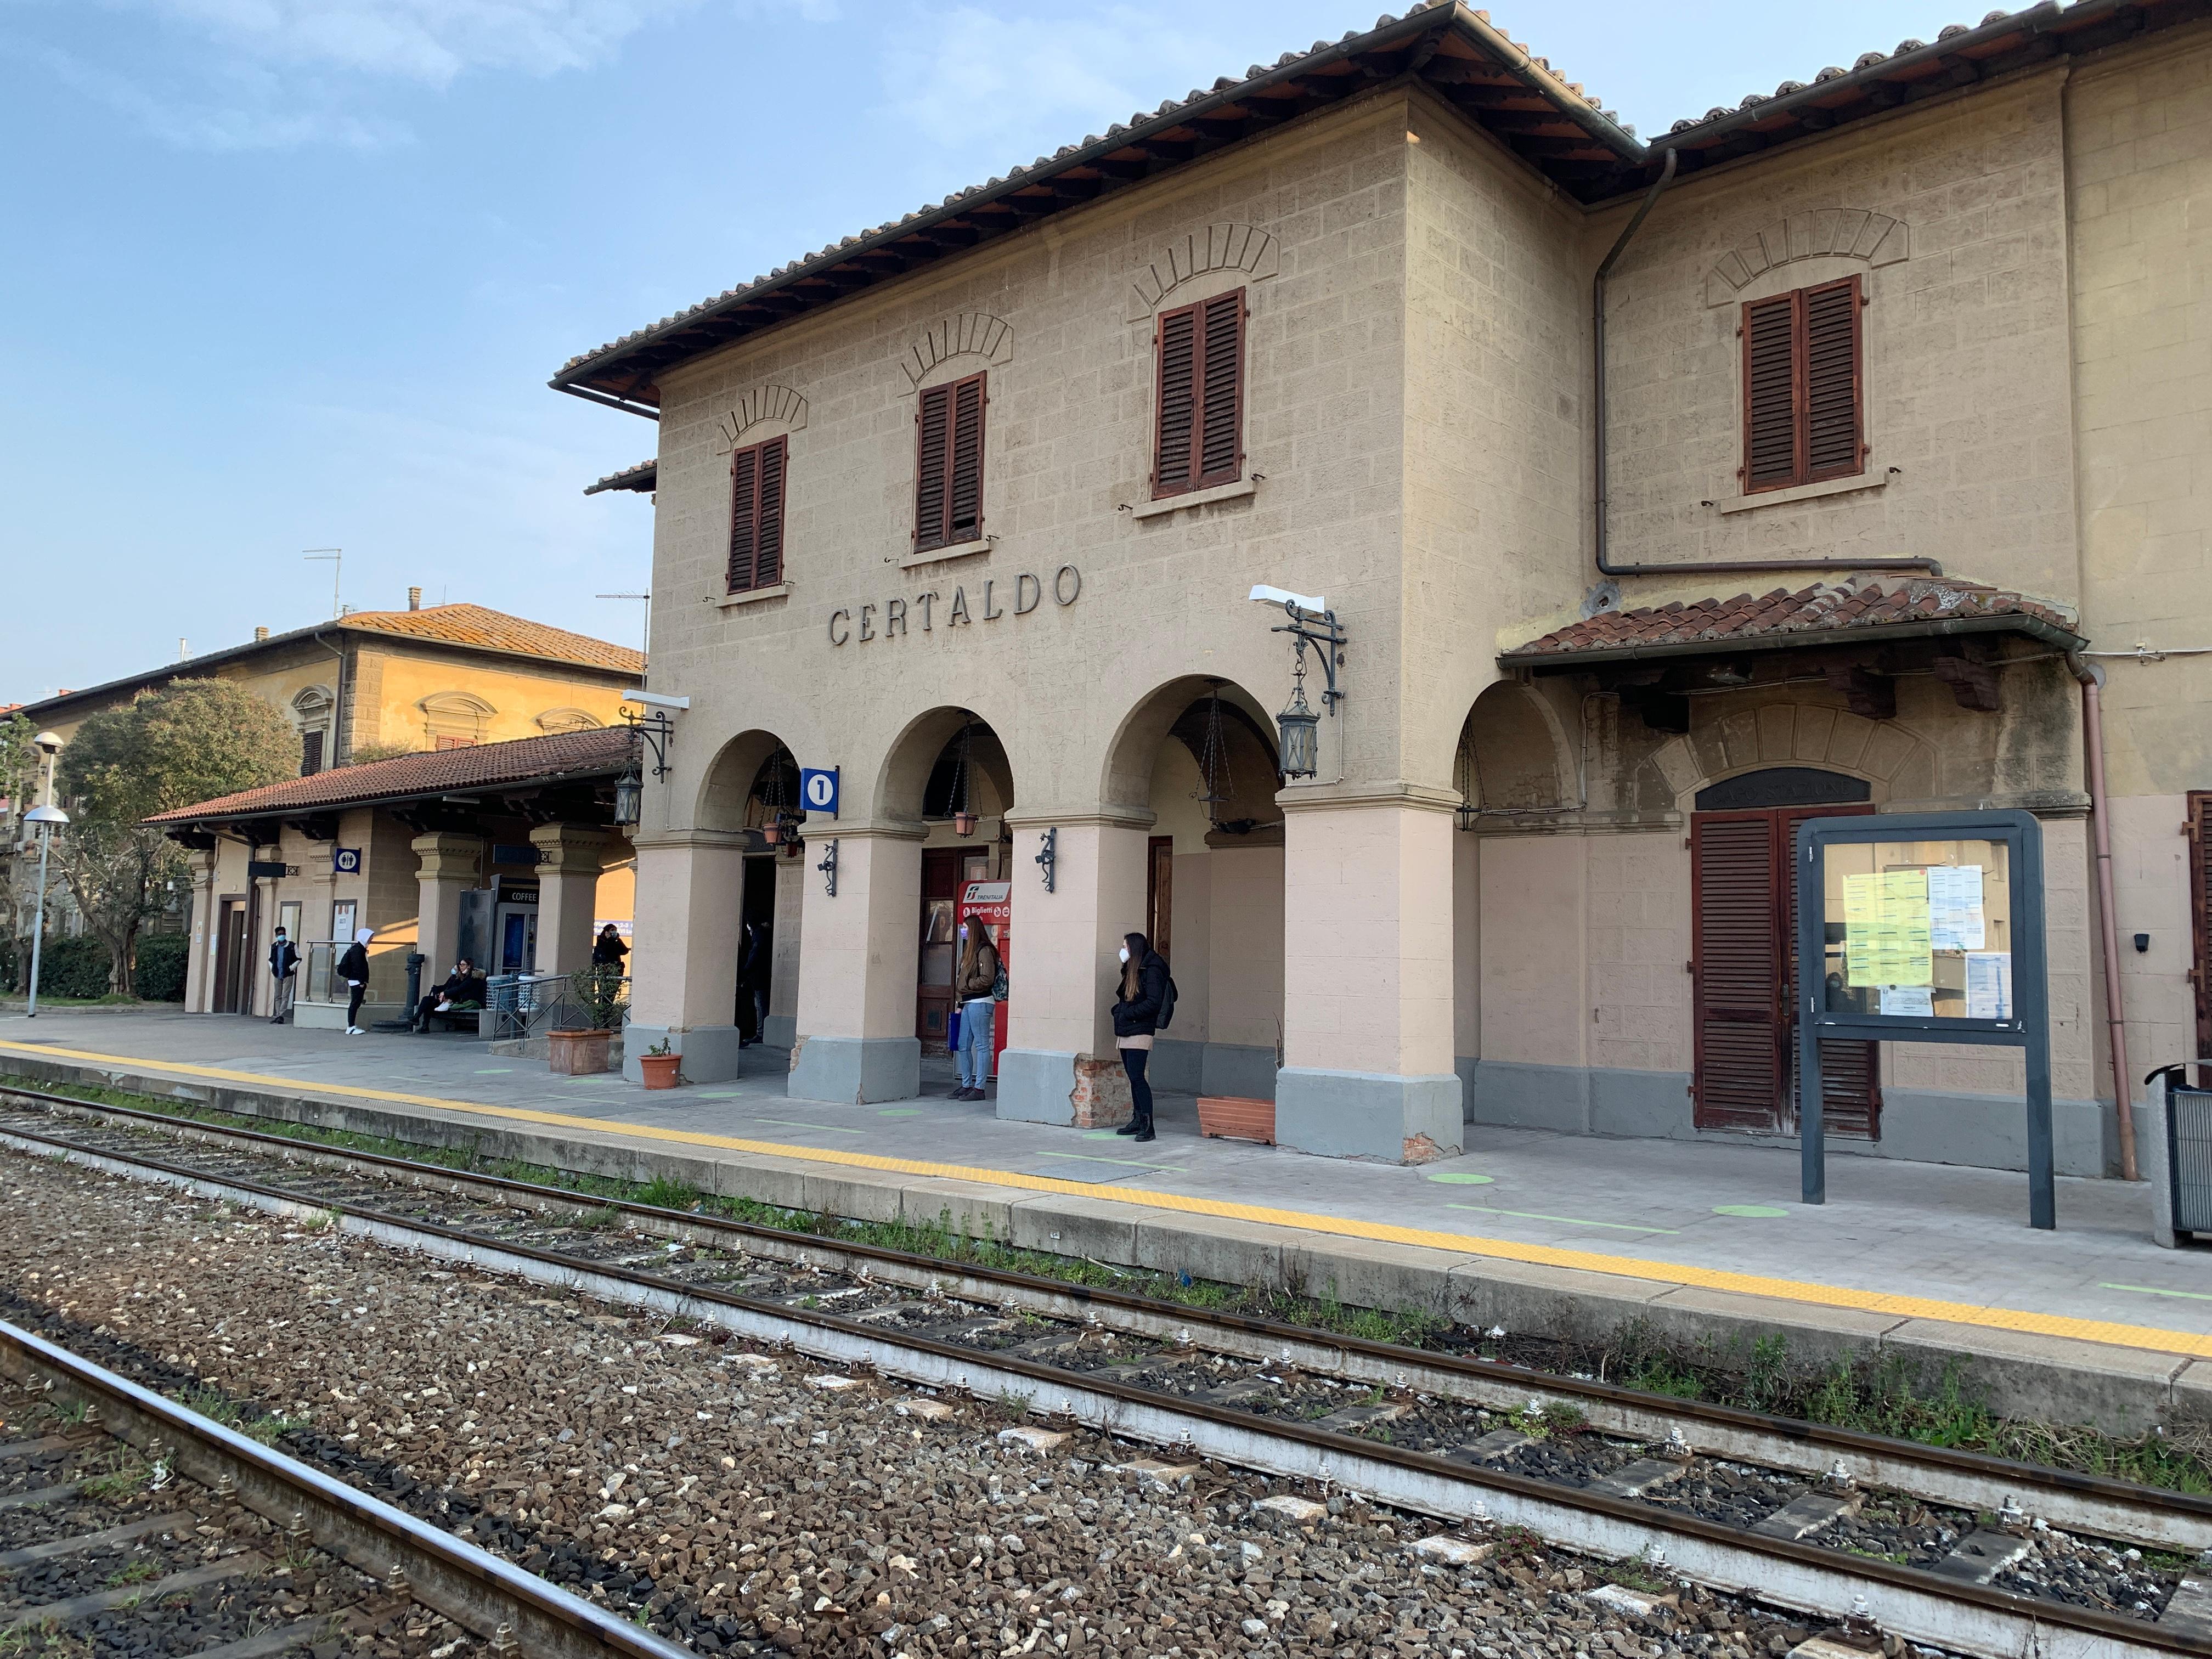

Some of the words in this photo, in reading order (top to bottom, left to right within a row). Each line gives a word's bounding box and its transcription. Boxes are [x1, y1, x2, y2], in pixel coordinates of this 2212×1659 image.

[829, 565, 1081, 646] CERTALDO
[817, 780, 824, 799] 1
[1712, 787, 1758, 803] CAPO
[1765, 780, 1850, 799] STAZIONE
[512, 892, 537, 901] COFFEE
[971, 906, 993, 915] Biglietti
